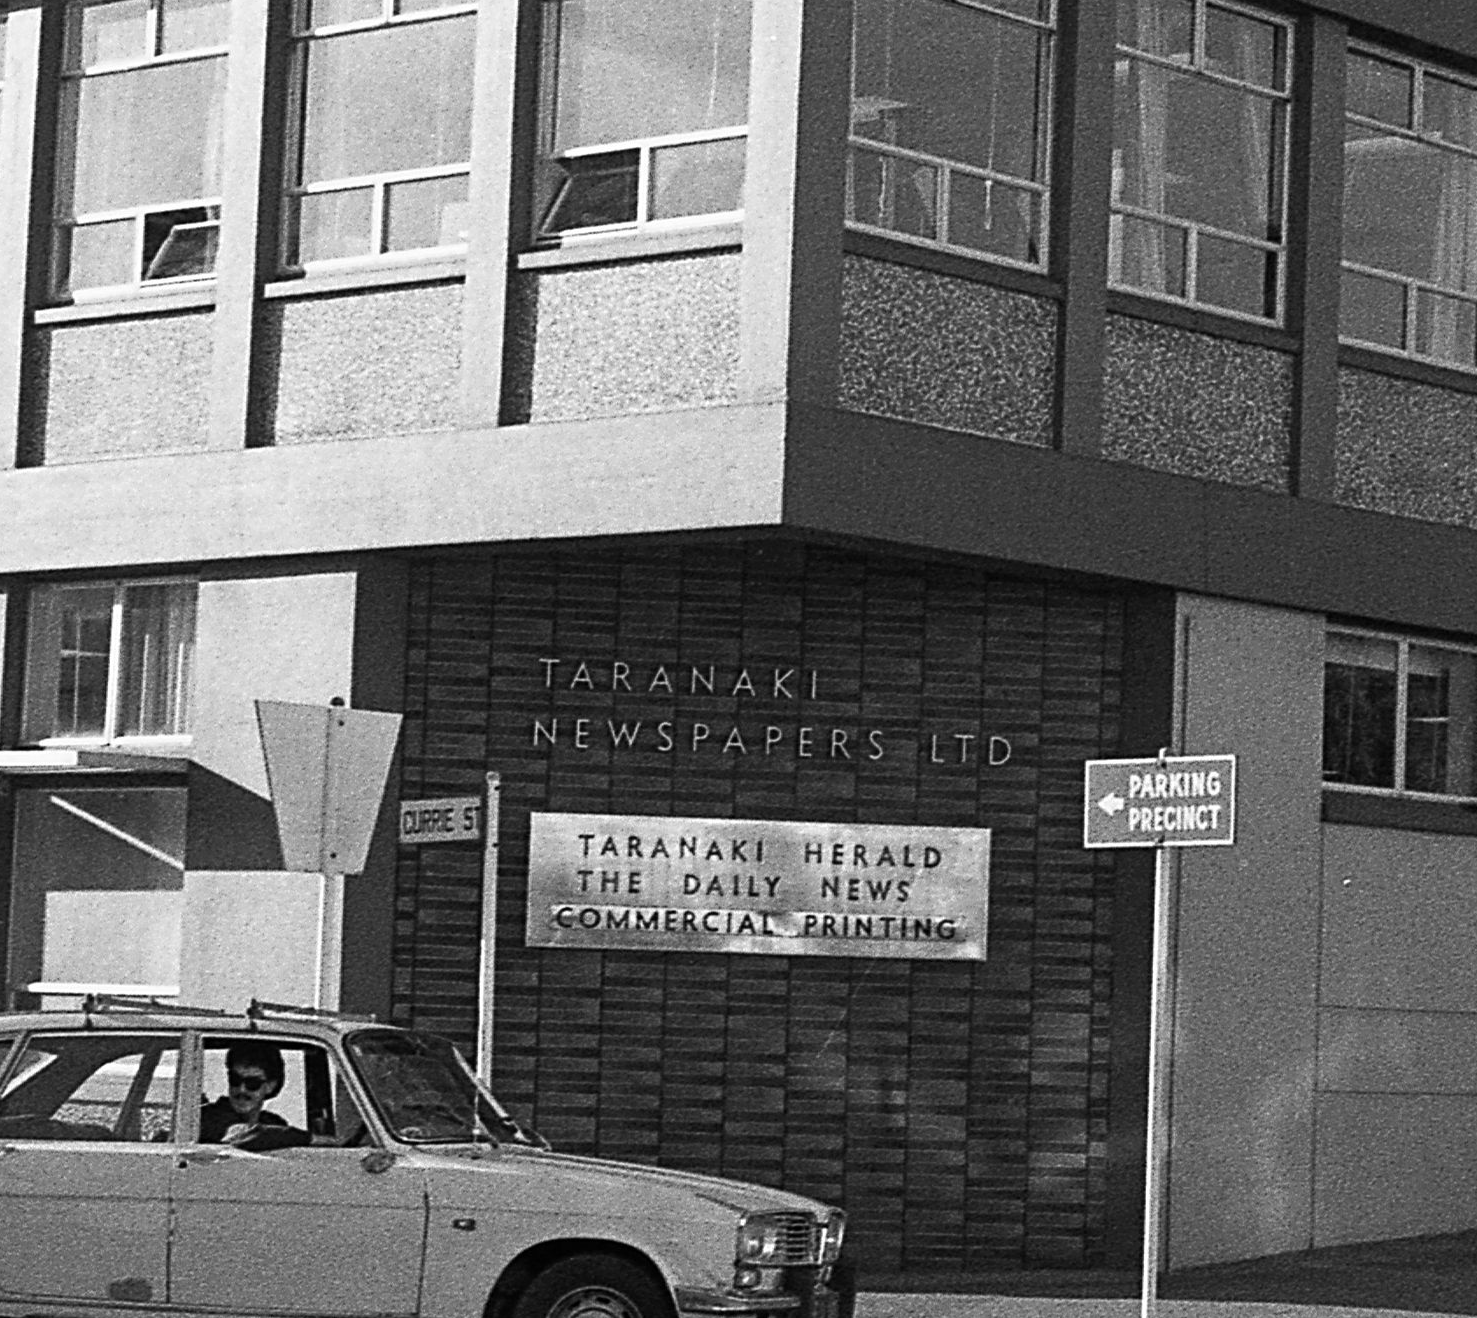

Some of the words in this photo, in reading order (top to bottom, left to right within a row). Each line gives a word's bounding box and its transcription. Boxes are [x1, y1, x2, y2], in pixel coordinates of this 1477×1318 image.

[539, 658, 817, 699] TARANAKI
[533, 718, 884, 760] NEWSPAPERS
[931, 734, 1012, 765] LTD
[1129, 771, 1221, 798] PARKING
[1128, 804, 1222, 831] PRECINCT
[578, 834, 764, 863] TARANAKI
[804, 843, 943, 869] HERALD
[577, 870, 642, 894] THE
[683, 873, 782, 898] DAILY
[821, 876, 911, 902] NEWS
[556, 906, 775, 936] COMMERCIAL
[804, 914, 957, 941] PRINTING
